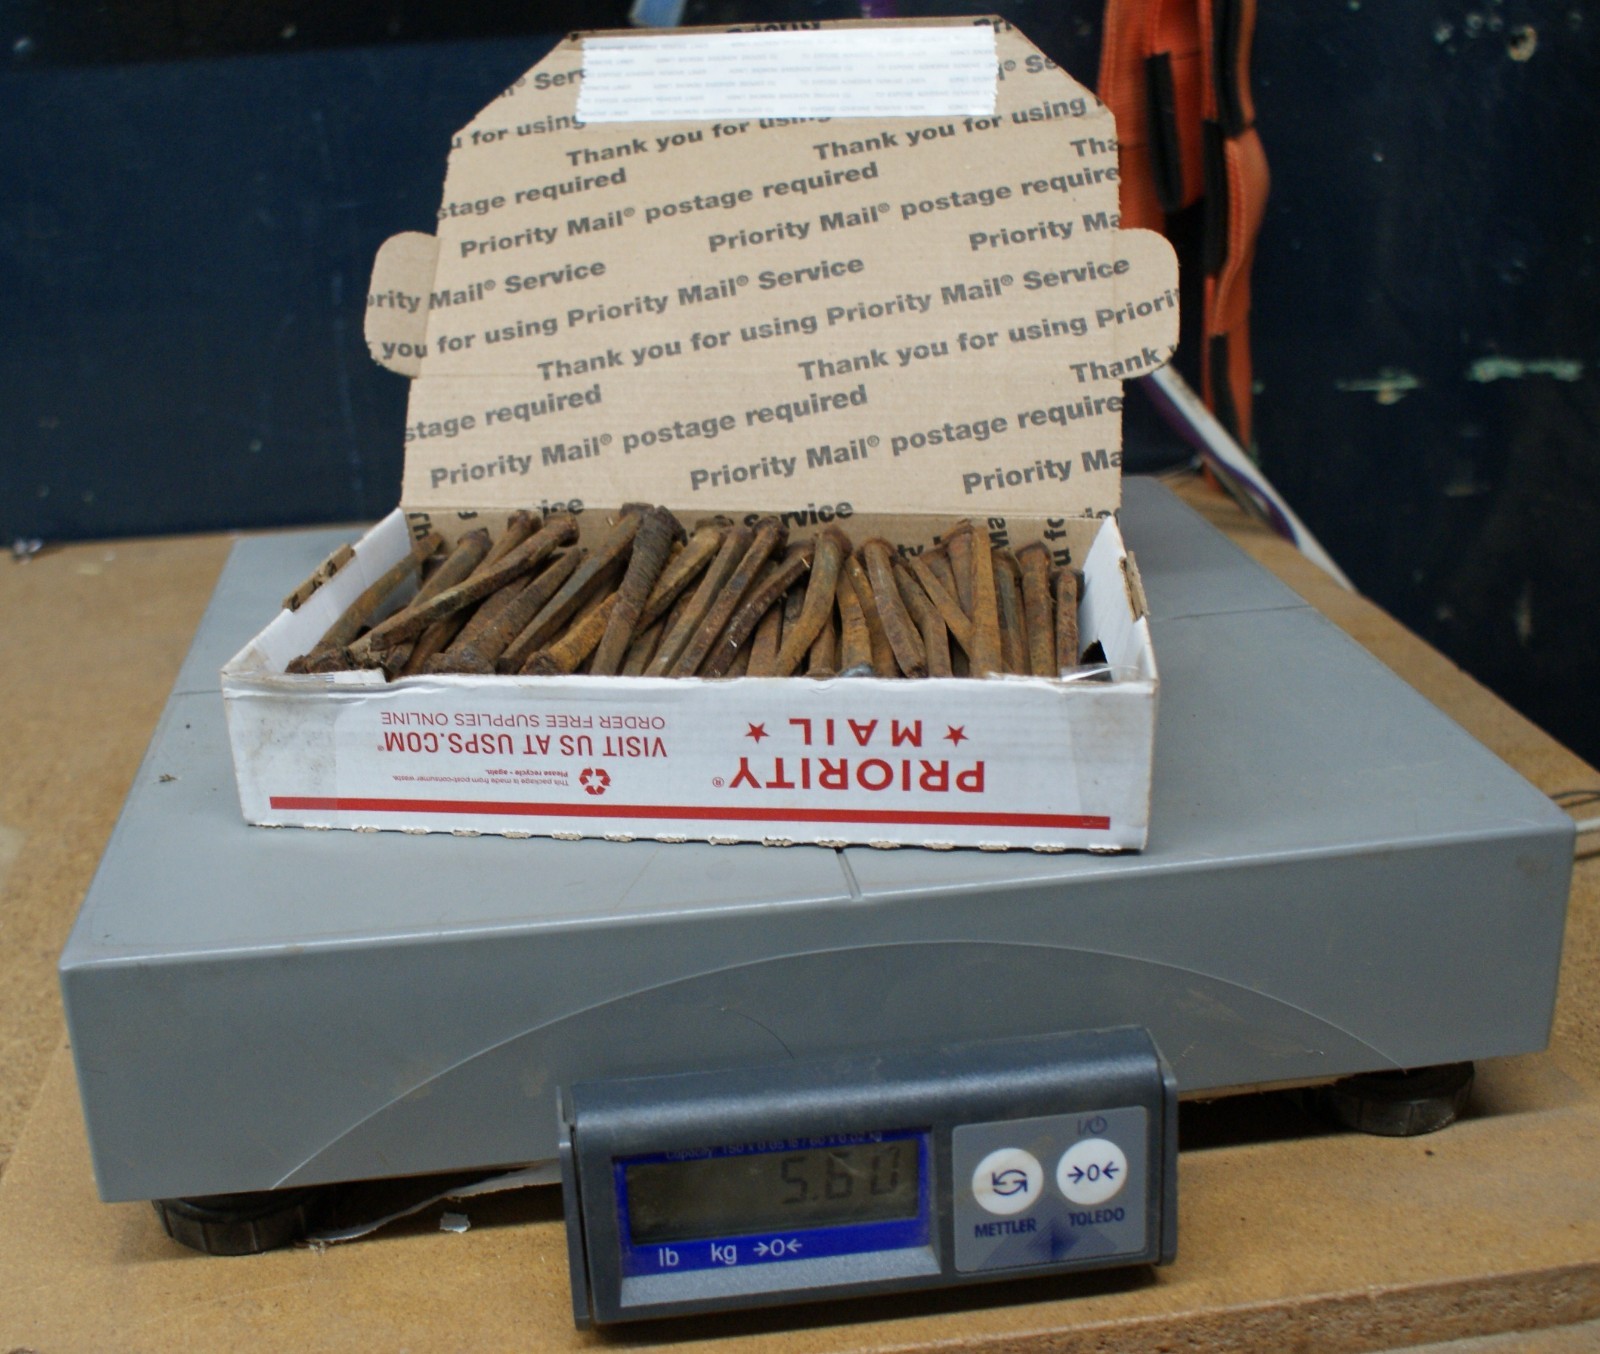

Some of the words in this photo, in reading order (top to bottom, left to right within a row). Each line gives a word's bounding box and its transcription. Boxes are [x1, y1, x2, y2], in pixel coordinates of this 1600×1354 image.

[471, 126, 508, 149] for
[566, 138, 649, 167] Thank
[656, 129, 703, 153] you
[712, 118, 751, 139] for
[813, 131, 899, 161] Thank
[906, 124, 956, 147] you
[964, 115, 1003, 134] for
[1012, 97, 1087, 124] using
[515, 167, 627, 204] required
[460, 224, 558, 258] Priority
[567, 206, 635, 237] Mail®
[645, 185, 753, 224] postage
[762, 161, 879, 198] required
[708, 219, 809, 253] Priority
[820, 203, 890, 232] Mail®
[900, 184, 1011, 219] postage
[969, 214, 1073, 251] Priority
[428, 279, 496, 310] Mail®
[505, 261, 606, 294] Service
[382, 341, 427, 361] you
[437, 332, 476, 354] for
[485, 317, 558, 344] using
[567, 293, 669, 328] Priority
[678, 274, 749, 306] Mail®
[757, 257, 865, 291] Service
[537, 349, 624, 381] Thank
[632, 341, 682, 366] you
[690, 330, 731, 351] for
[740, 314, 818, 344] using
[826, 291, 932, 326] Priority
[941, 274, 1013, 305] Mail®
[1024, 258, 1130, 290] Service
[798, 348, 890, 381] Thank
[897, 341, 949, 366] you
[957, 332, 999, 352] for
[1008, 316, 1088, 343] using
[1069, 347, 1161, 383] Thank
[486, 384, 602, 426] required
[431, 454, 532, 489] Priority
[542, 433, 613, 467] Mail®
[623, 415, 736, 454] postage
[745, 384, 867, 427] required
[690, 455, 797, 490] Priority
[806, 435, 880, 469] Mail®
[892, 415, 1008, 456] postage
[963, 458, 1072, 494] Priority
[380, 712, 449, 727] ONLINE
[454, 713, 539, 728] SUPPLIES
[545, 714, 593, 729] FREE
[598, 715, 665, 730] ORDER
[789, 717, 923, 749] MAIL
[523, 734, 550, 755] AT
[559, 735, 593, 756] US
[602, 735, 667, 758] VISIT
[515, 769, 542, 777] recycle
[520, 777, 552, 785] package
[780, 1146, 900, 1204] 5.60
[974, 1218, 1037, 1237] METTLER
[1068, 1207, 1125, 1227] TOLEDO
[658, 1247, 679, 1267] lb
[711, 1242, 737, 1265] kg
